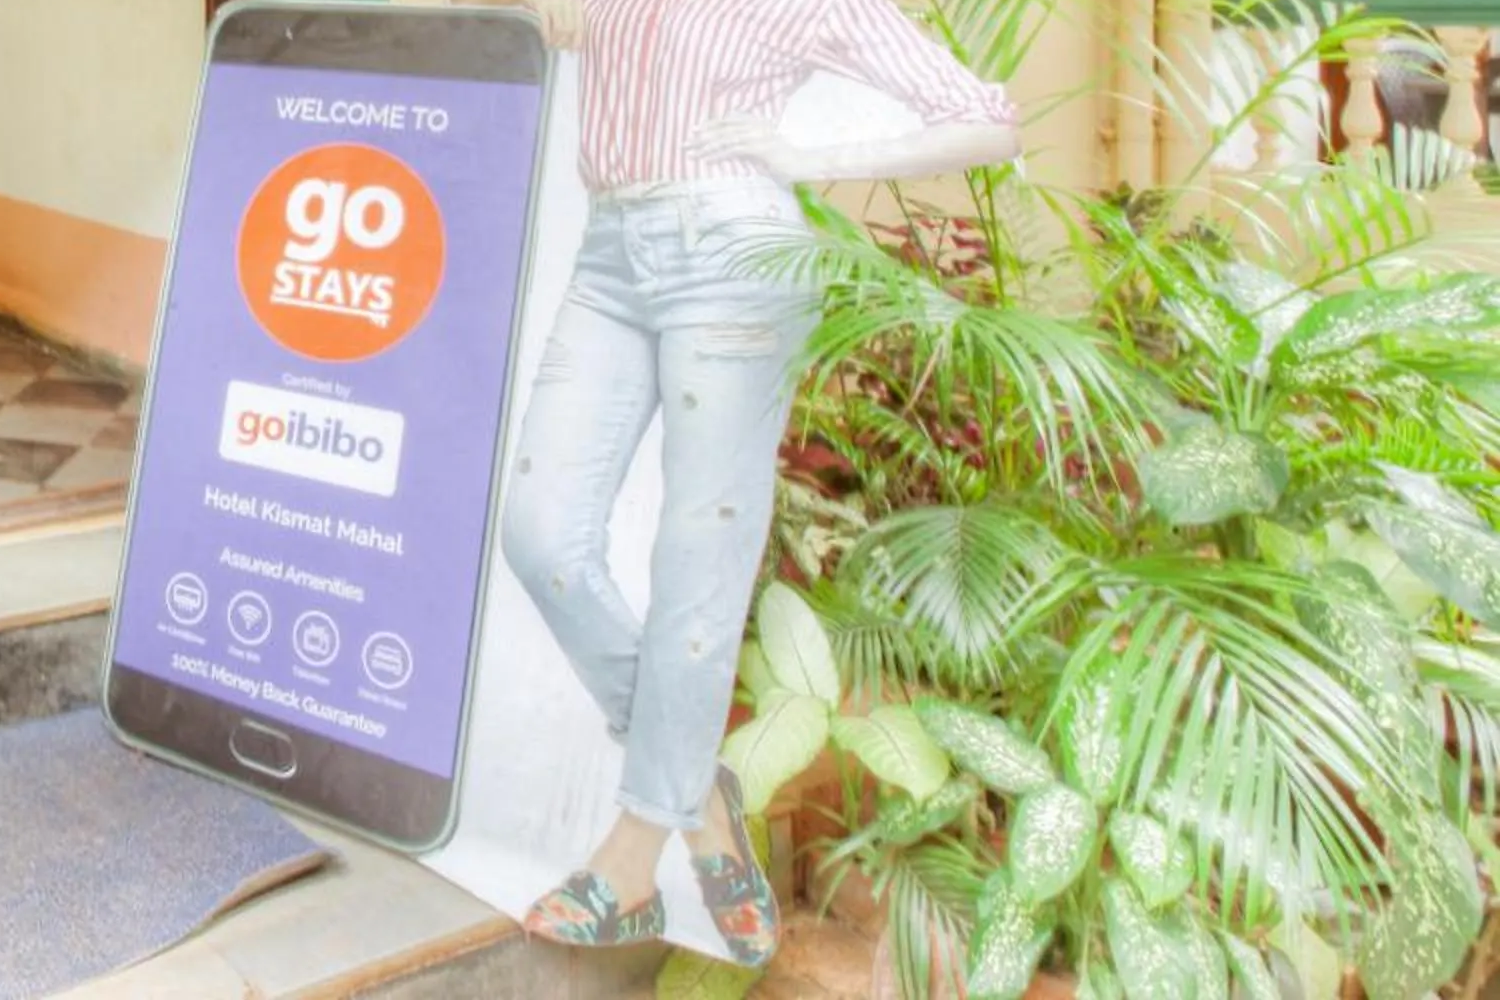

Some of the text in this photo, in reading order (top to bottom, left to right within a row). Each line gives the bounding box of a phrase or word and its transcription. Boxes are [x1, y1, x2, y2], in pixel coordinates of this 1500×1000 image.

[275, 96, 449, 132] WELCOME TO
[284, 176, 405, 262] go
[273, 261, 395, 311] STAYS
[281, 372, 353, 398] Certified by
[236, 409, 384, 462] goibibo
[204, 484, 404, 556] Hotel Kismat Mahal
[219, 546, 365, 603] Assured Amenities
[170, 652, 209, 678] 100%
[211, 664, 261, 699] Money
[262, 681, 300, 709] Back
[301, 695, 388, 738] Guarantee
